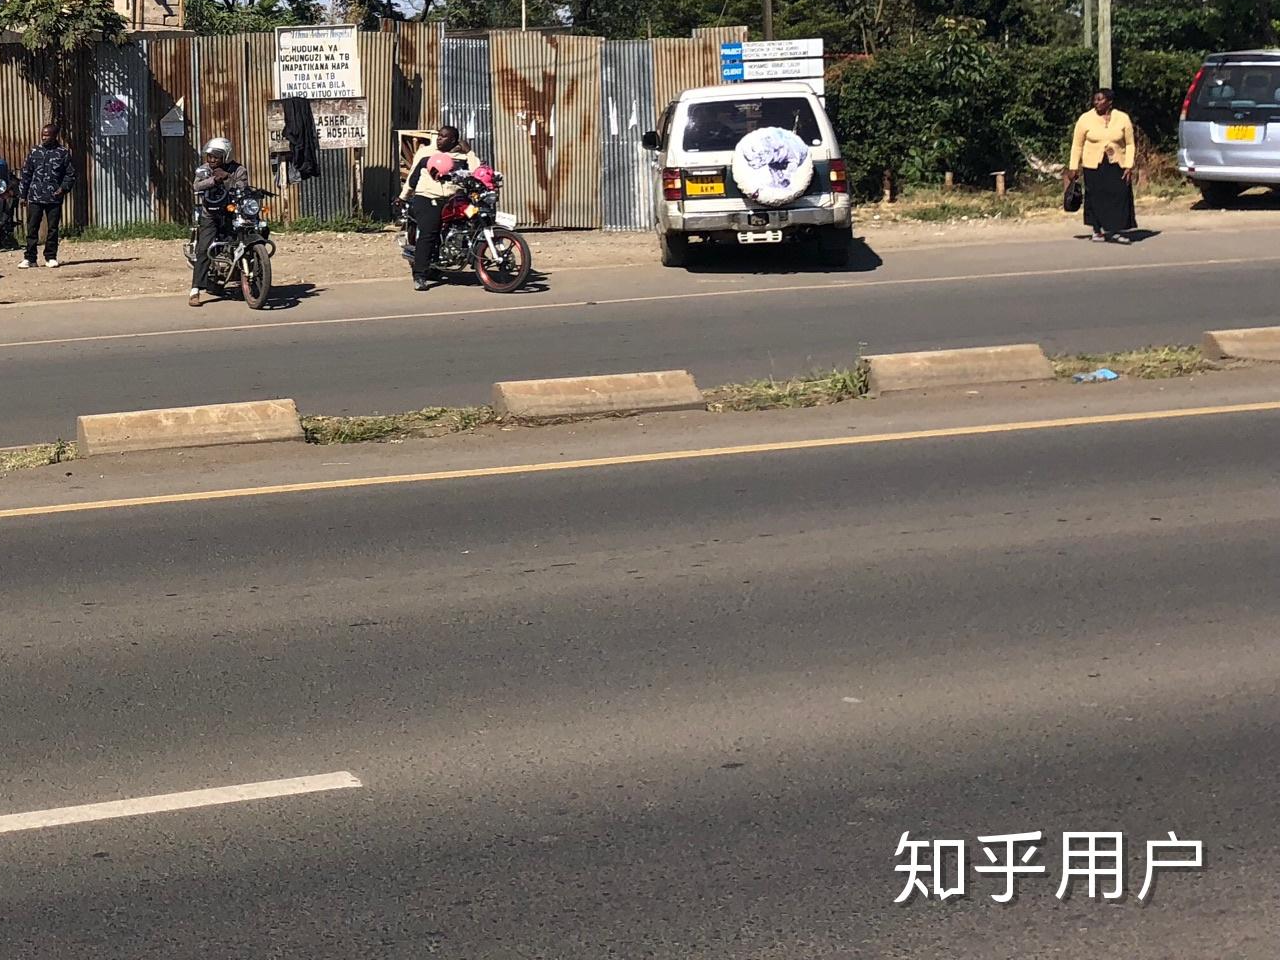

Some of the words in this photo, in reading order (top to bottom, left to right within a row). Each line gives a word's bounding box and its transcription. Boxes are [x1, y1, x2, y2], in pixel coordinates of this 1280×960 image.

[291, 45, 324, 53] HUDUMA
[328, 44, 338, 52] YA
[280, 54, 322, 62] UCHUNGUZI
[324, 53, 335, 61] WA
[339, 53, 350, 61] TB
[282, 63, 328, 71] INAPATIKANA
[331, 62, 349, 70] HAPA
[294, 73, 310, 81] TIBA
[326, 72, 336, 80] TB
[286, 81, 326, 90] INATOLEWA
[281, 90, 308, 99] MALIPO
[334, 89, 355, 97] VYOTE
[326, 127, 365, 139] HOSPITAL
